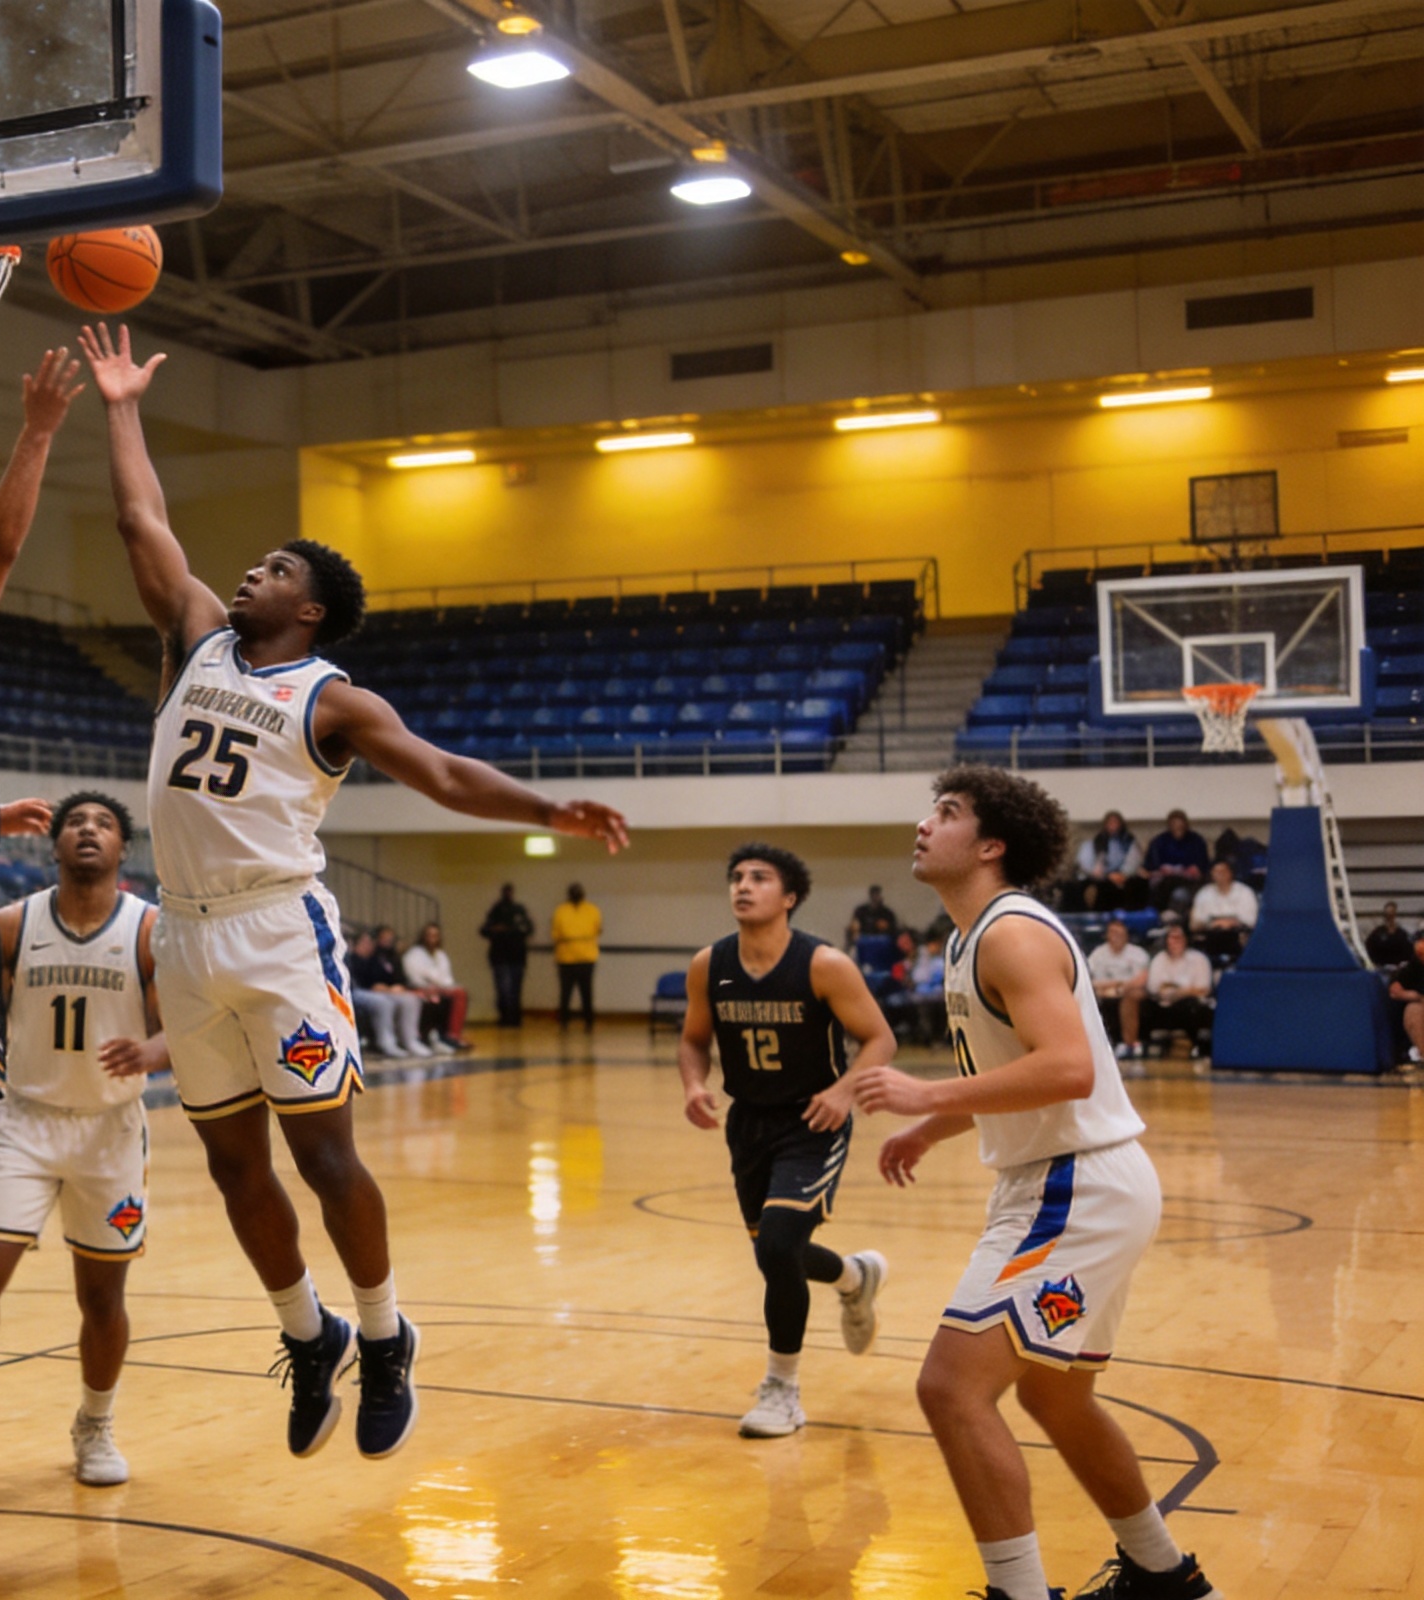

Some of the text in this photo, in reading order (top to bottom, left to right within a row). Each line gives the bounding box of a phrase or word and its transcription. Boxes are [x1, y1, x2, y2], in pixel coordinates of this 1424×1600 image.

[167, 719, 258, 799] 25
[50, 994, 87, 1051] 11
[741, 1028, 782, 1070] 12
